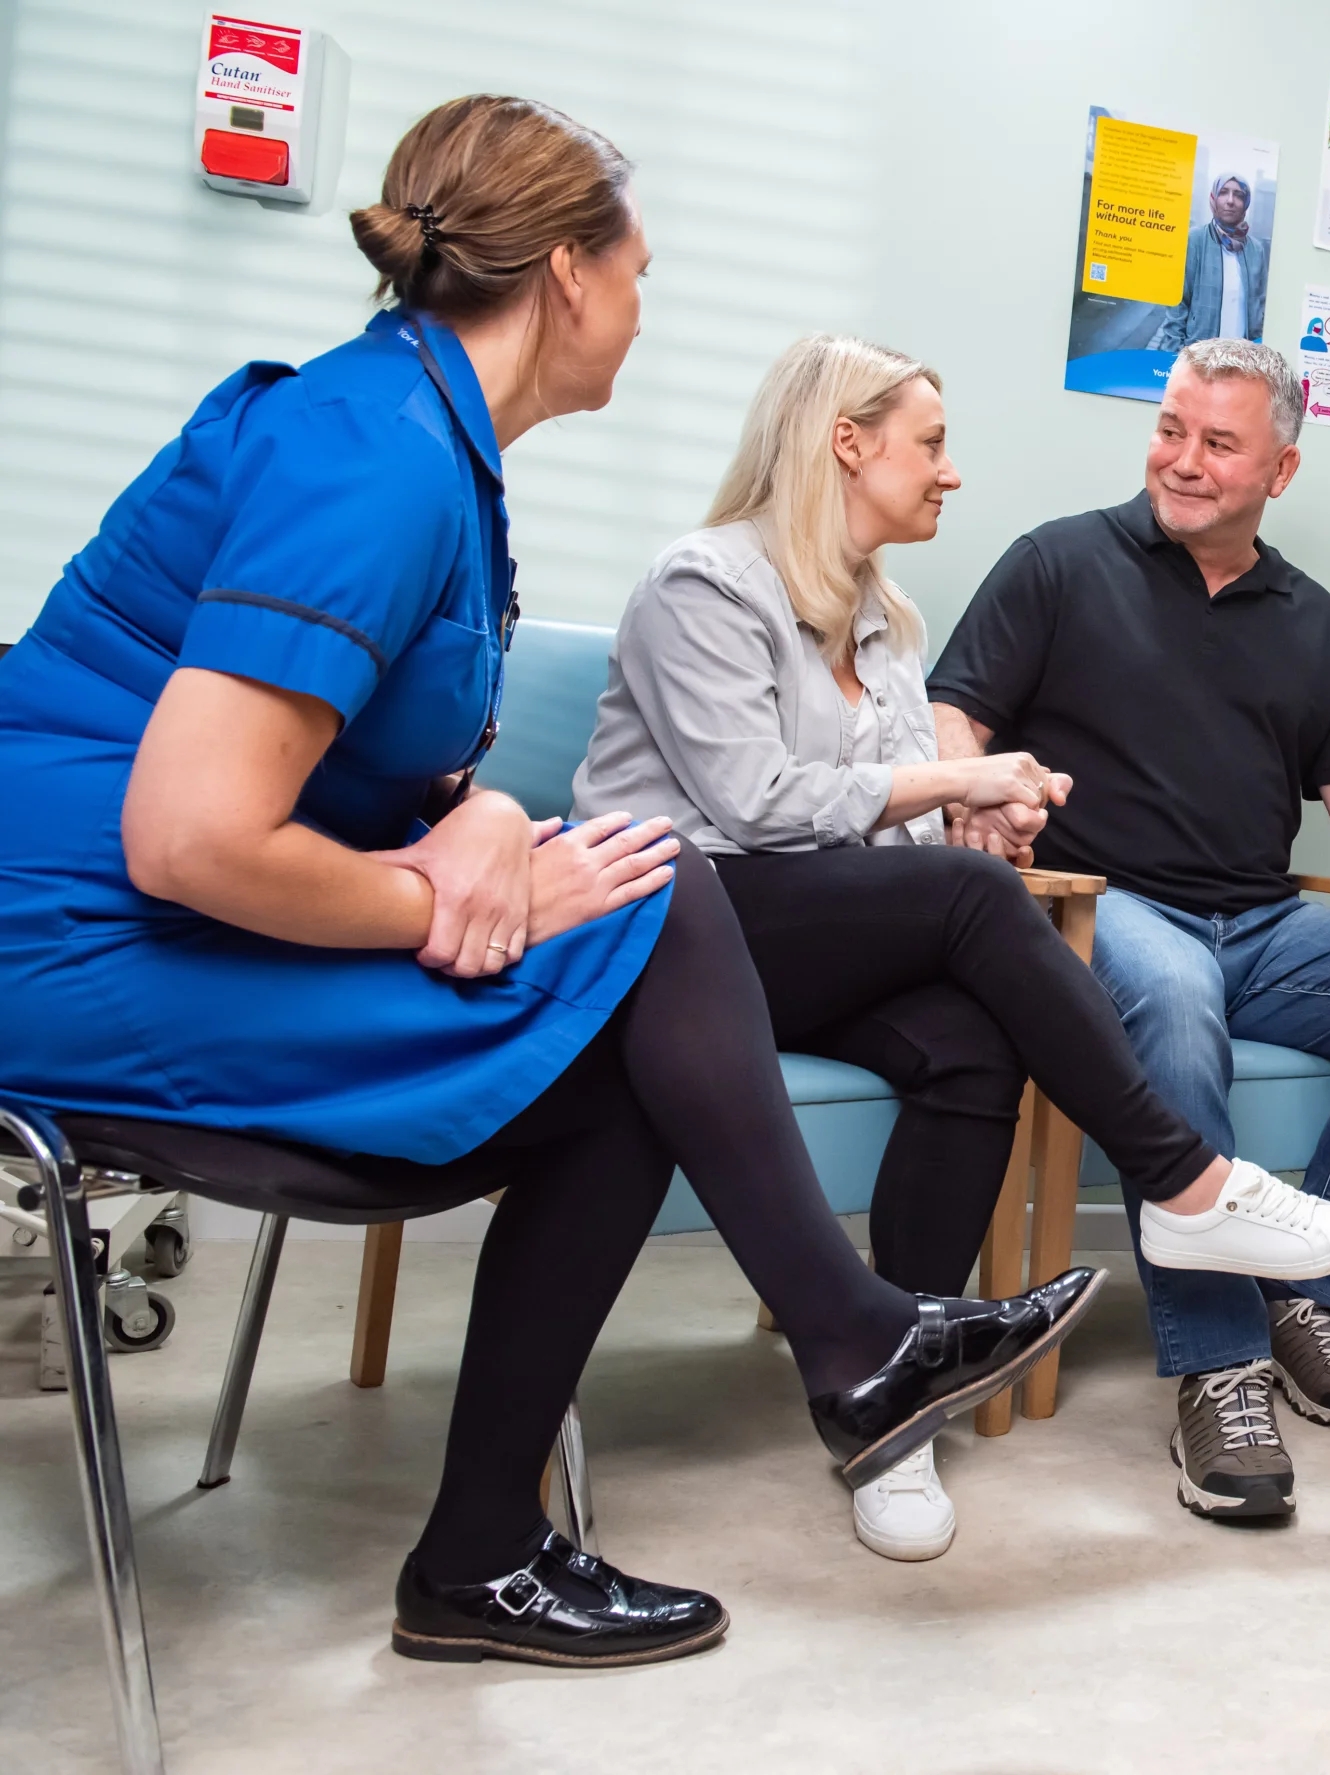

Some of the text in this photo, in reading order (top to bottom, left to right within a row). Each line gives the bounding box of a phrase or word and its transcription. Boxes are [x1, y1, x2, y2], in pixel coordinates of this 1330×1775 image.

[211, 62, 261, 82] Cutan
[211, 76, 292, 98] Hand Sanitiser
[1097, 200, 1165, 220] For more life
[1096, 212, 1176, 232] without cancer
[1095, 230, 1117, 239] Thank
